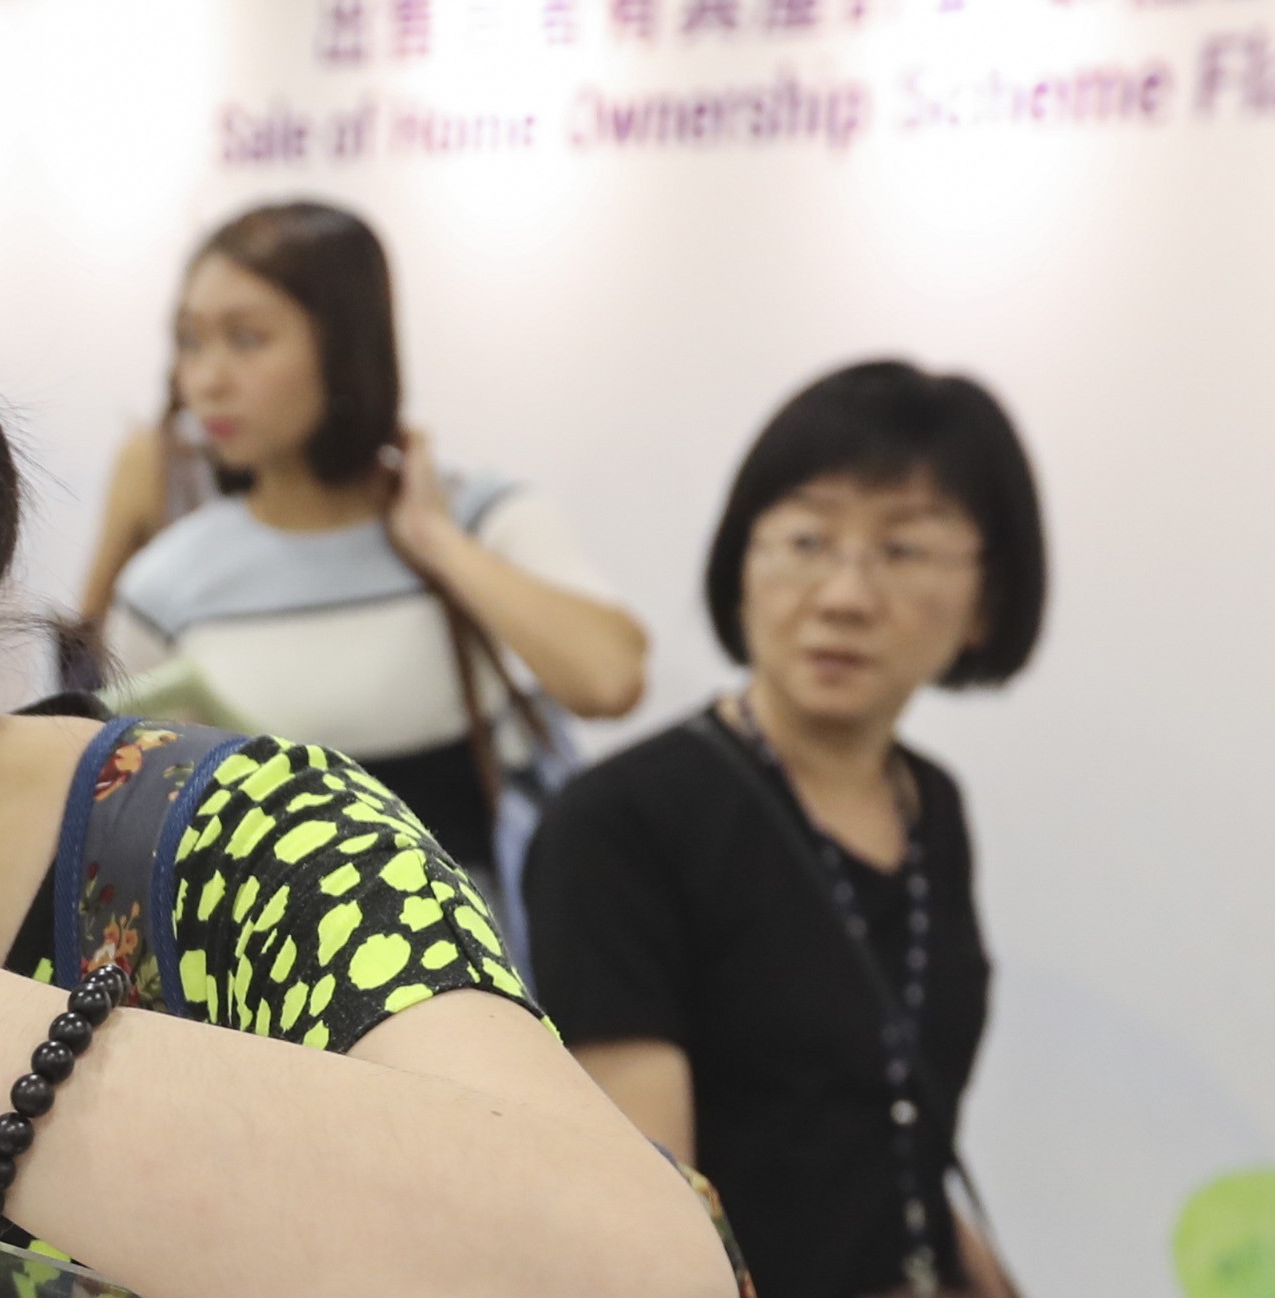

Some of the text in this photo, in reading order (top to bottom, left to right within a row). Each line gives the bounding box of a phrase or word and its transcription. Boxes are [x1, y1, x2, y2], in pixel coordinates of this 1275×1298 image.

[217, 93, 311, 165] Sale
[325, 90, 378, 160] of
[565, 66, 870, 154] Ownership
